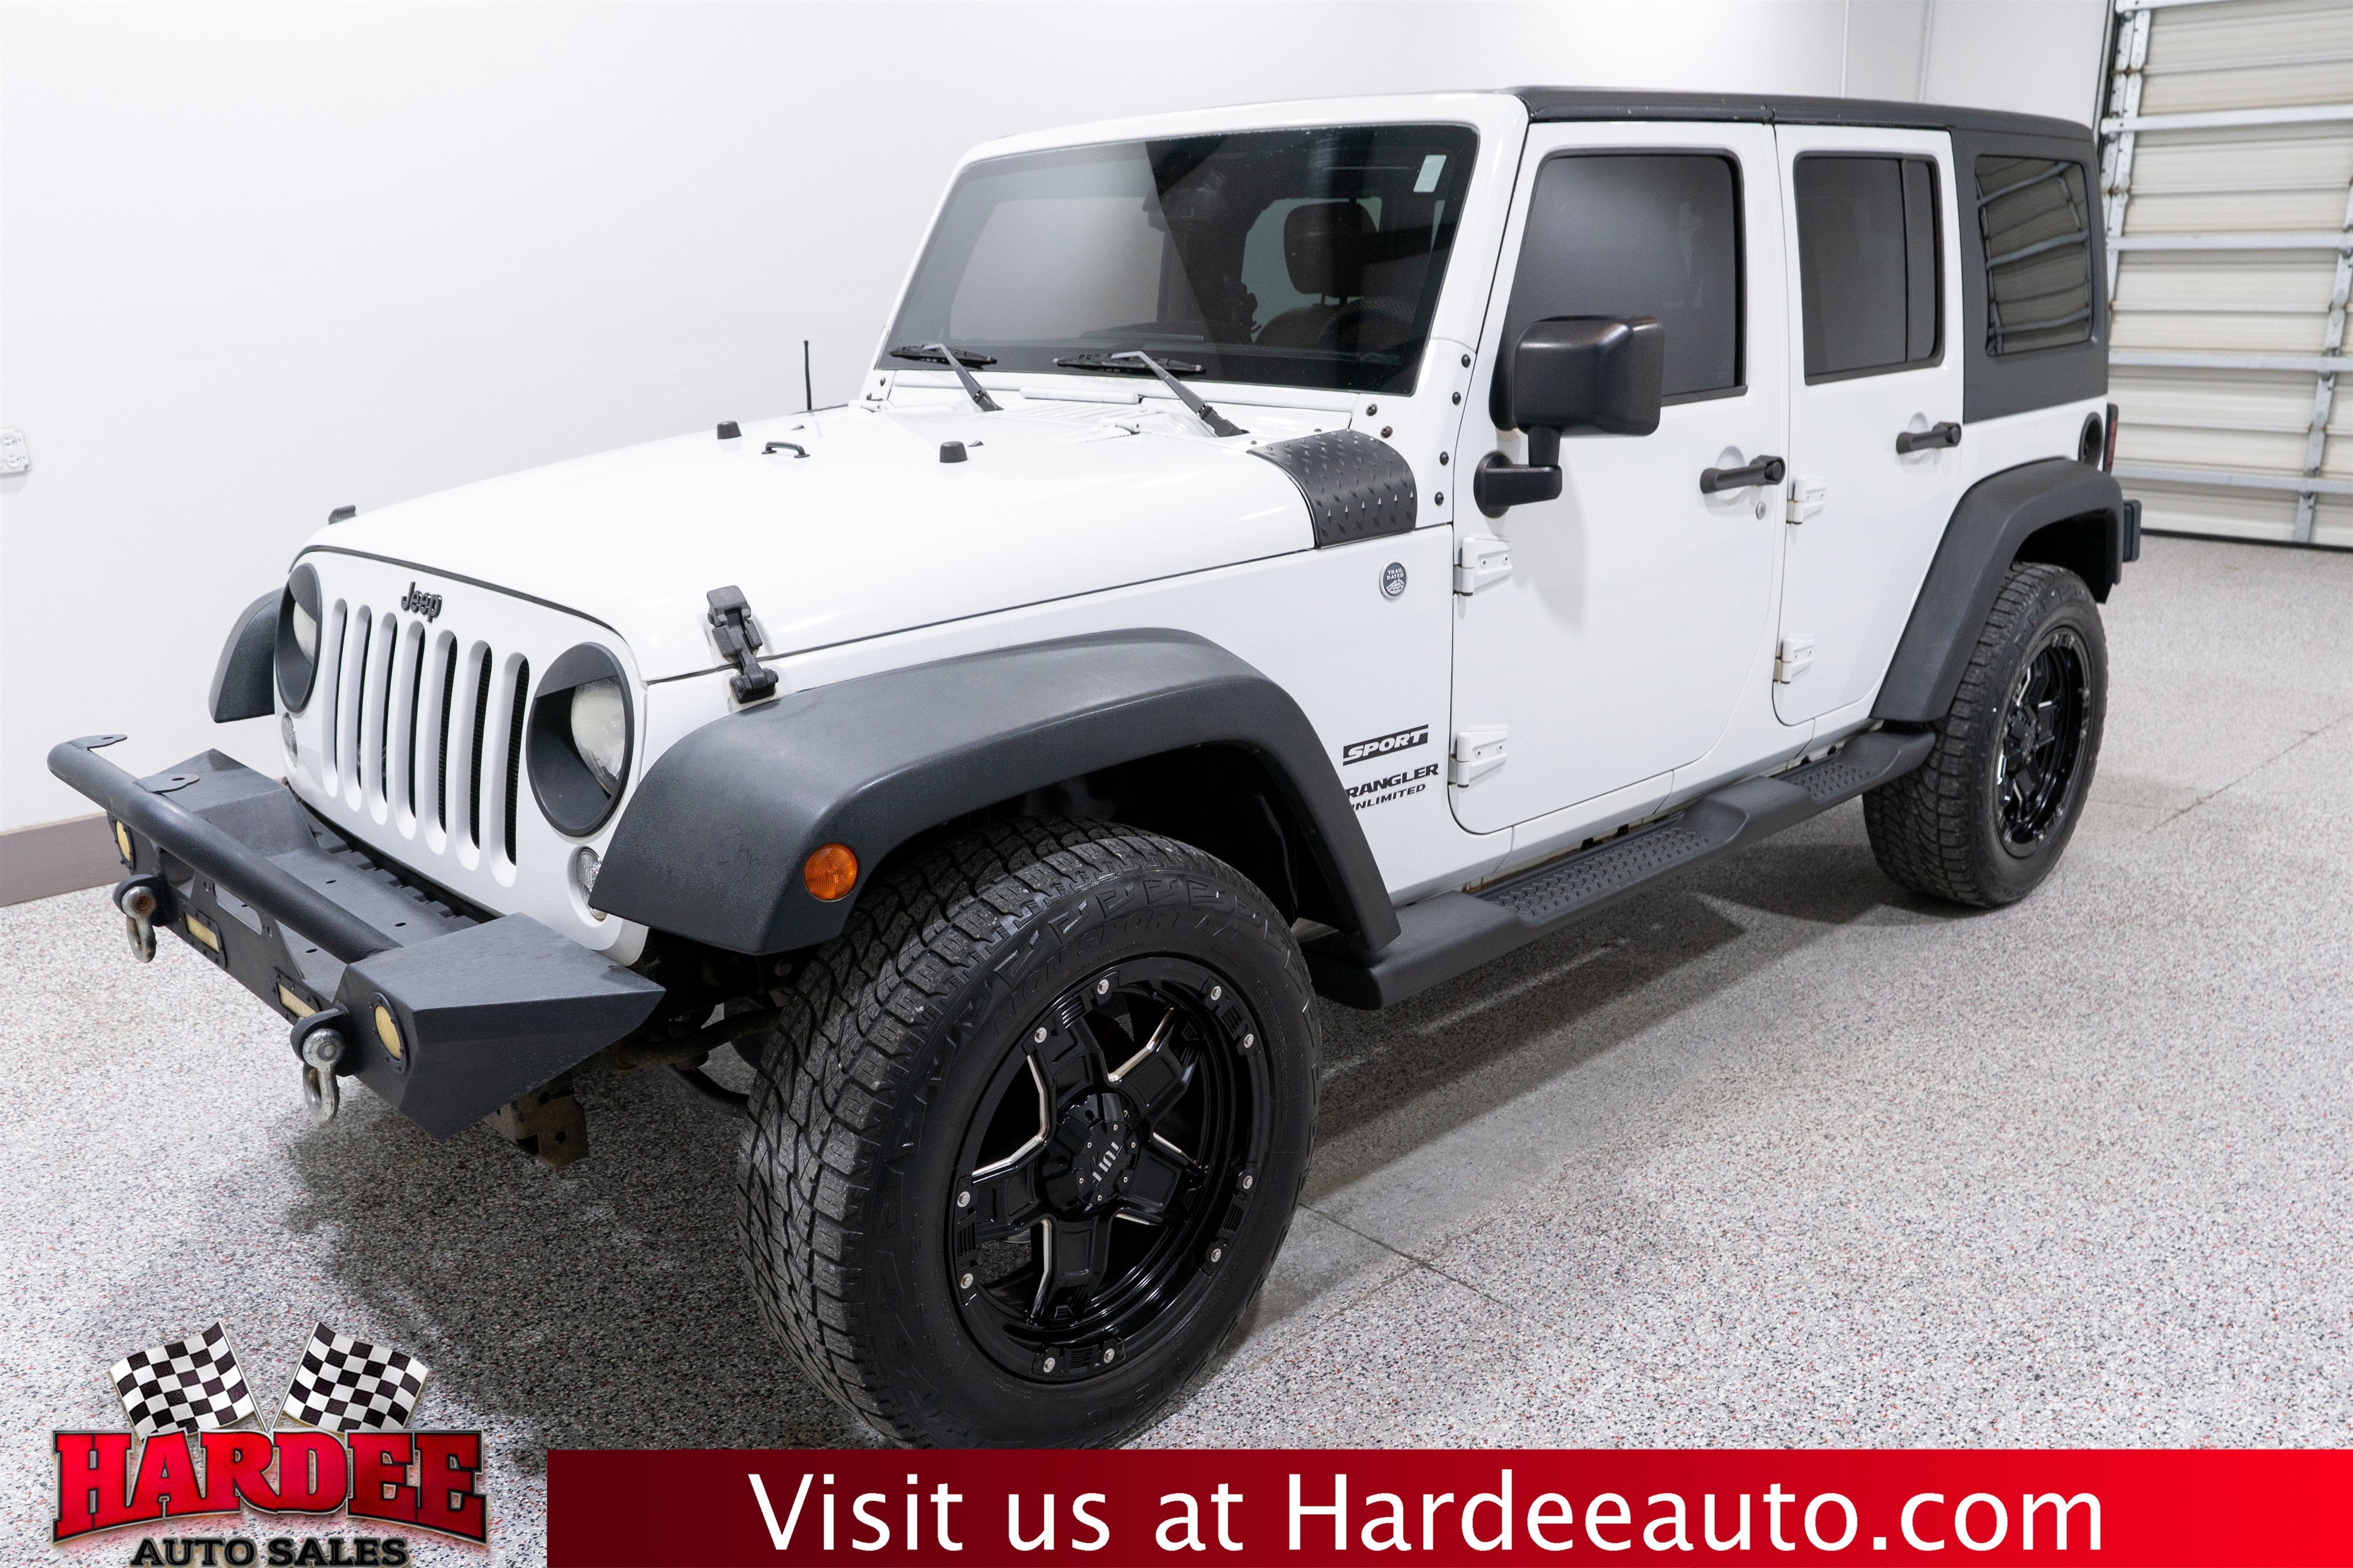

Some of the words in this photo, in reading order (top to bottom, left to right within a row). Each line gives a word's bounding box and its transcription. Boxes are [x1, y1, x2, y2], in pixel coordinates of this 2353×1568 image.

[1386, 573, 1404, 581] RATED
[400, 581, 442, 623] Jeep
[1343, 727, 1428, 762] SPORT
[1345, 763, 1438, 800] RANGLER
